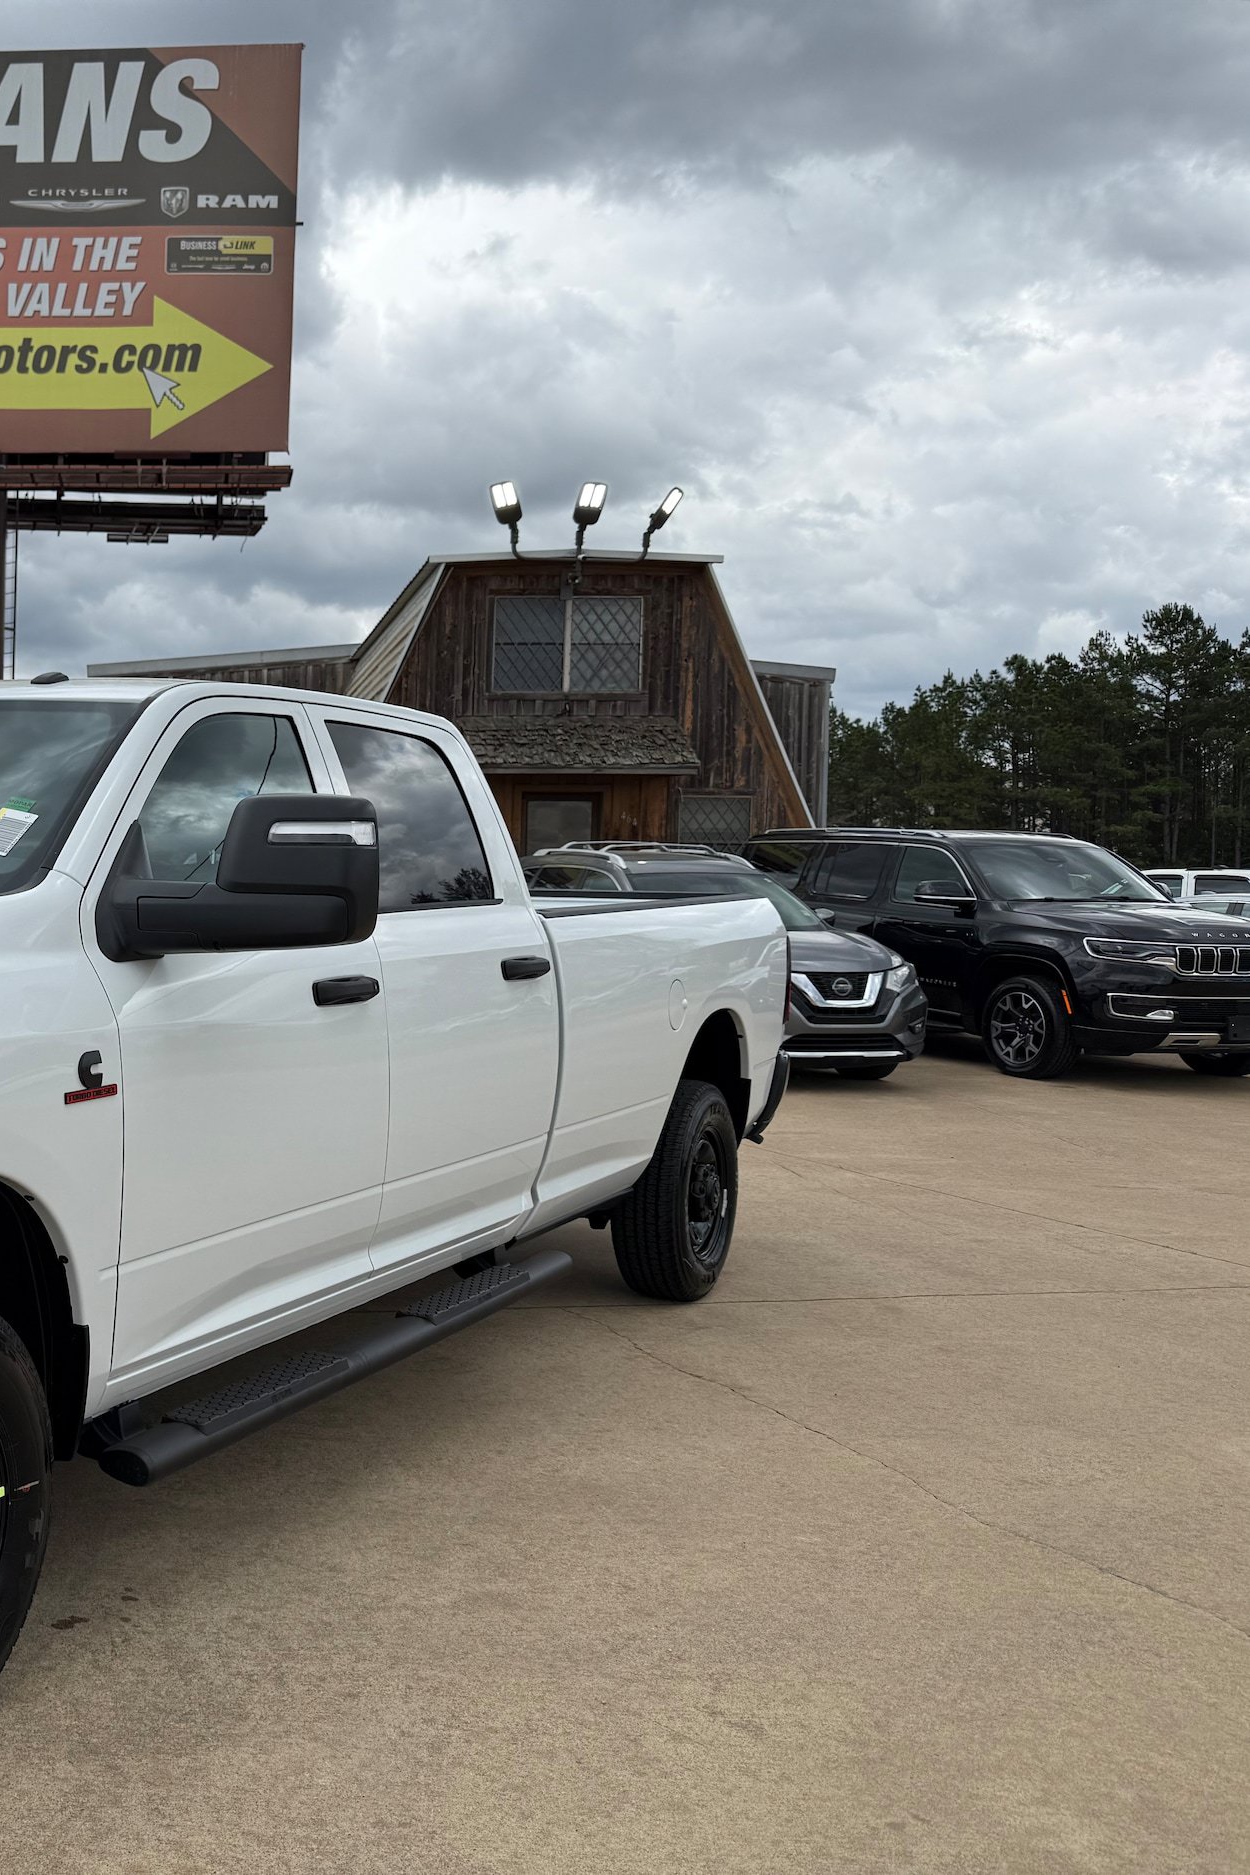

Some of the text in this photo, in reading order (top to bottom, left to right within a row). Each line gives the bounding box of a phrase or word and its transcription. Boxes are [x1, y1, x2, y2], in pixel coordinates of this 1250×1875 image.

[27, 187, 129, 197] CHRYSLER
[196, 194, 279, 209] RAM
[180, 240, 256, 250] BUSINESS LINK
[17, 237, 60, 272] IN
[71, 236, 142, 272] THE
[7, 282, 147, 318] VALLEY
